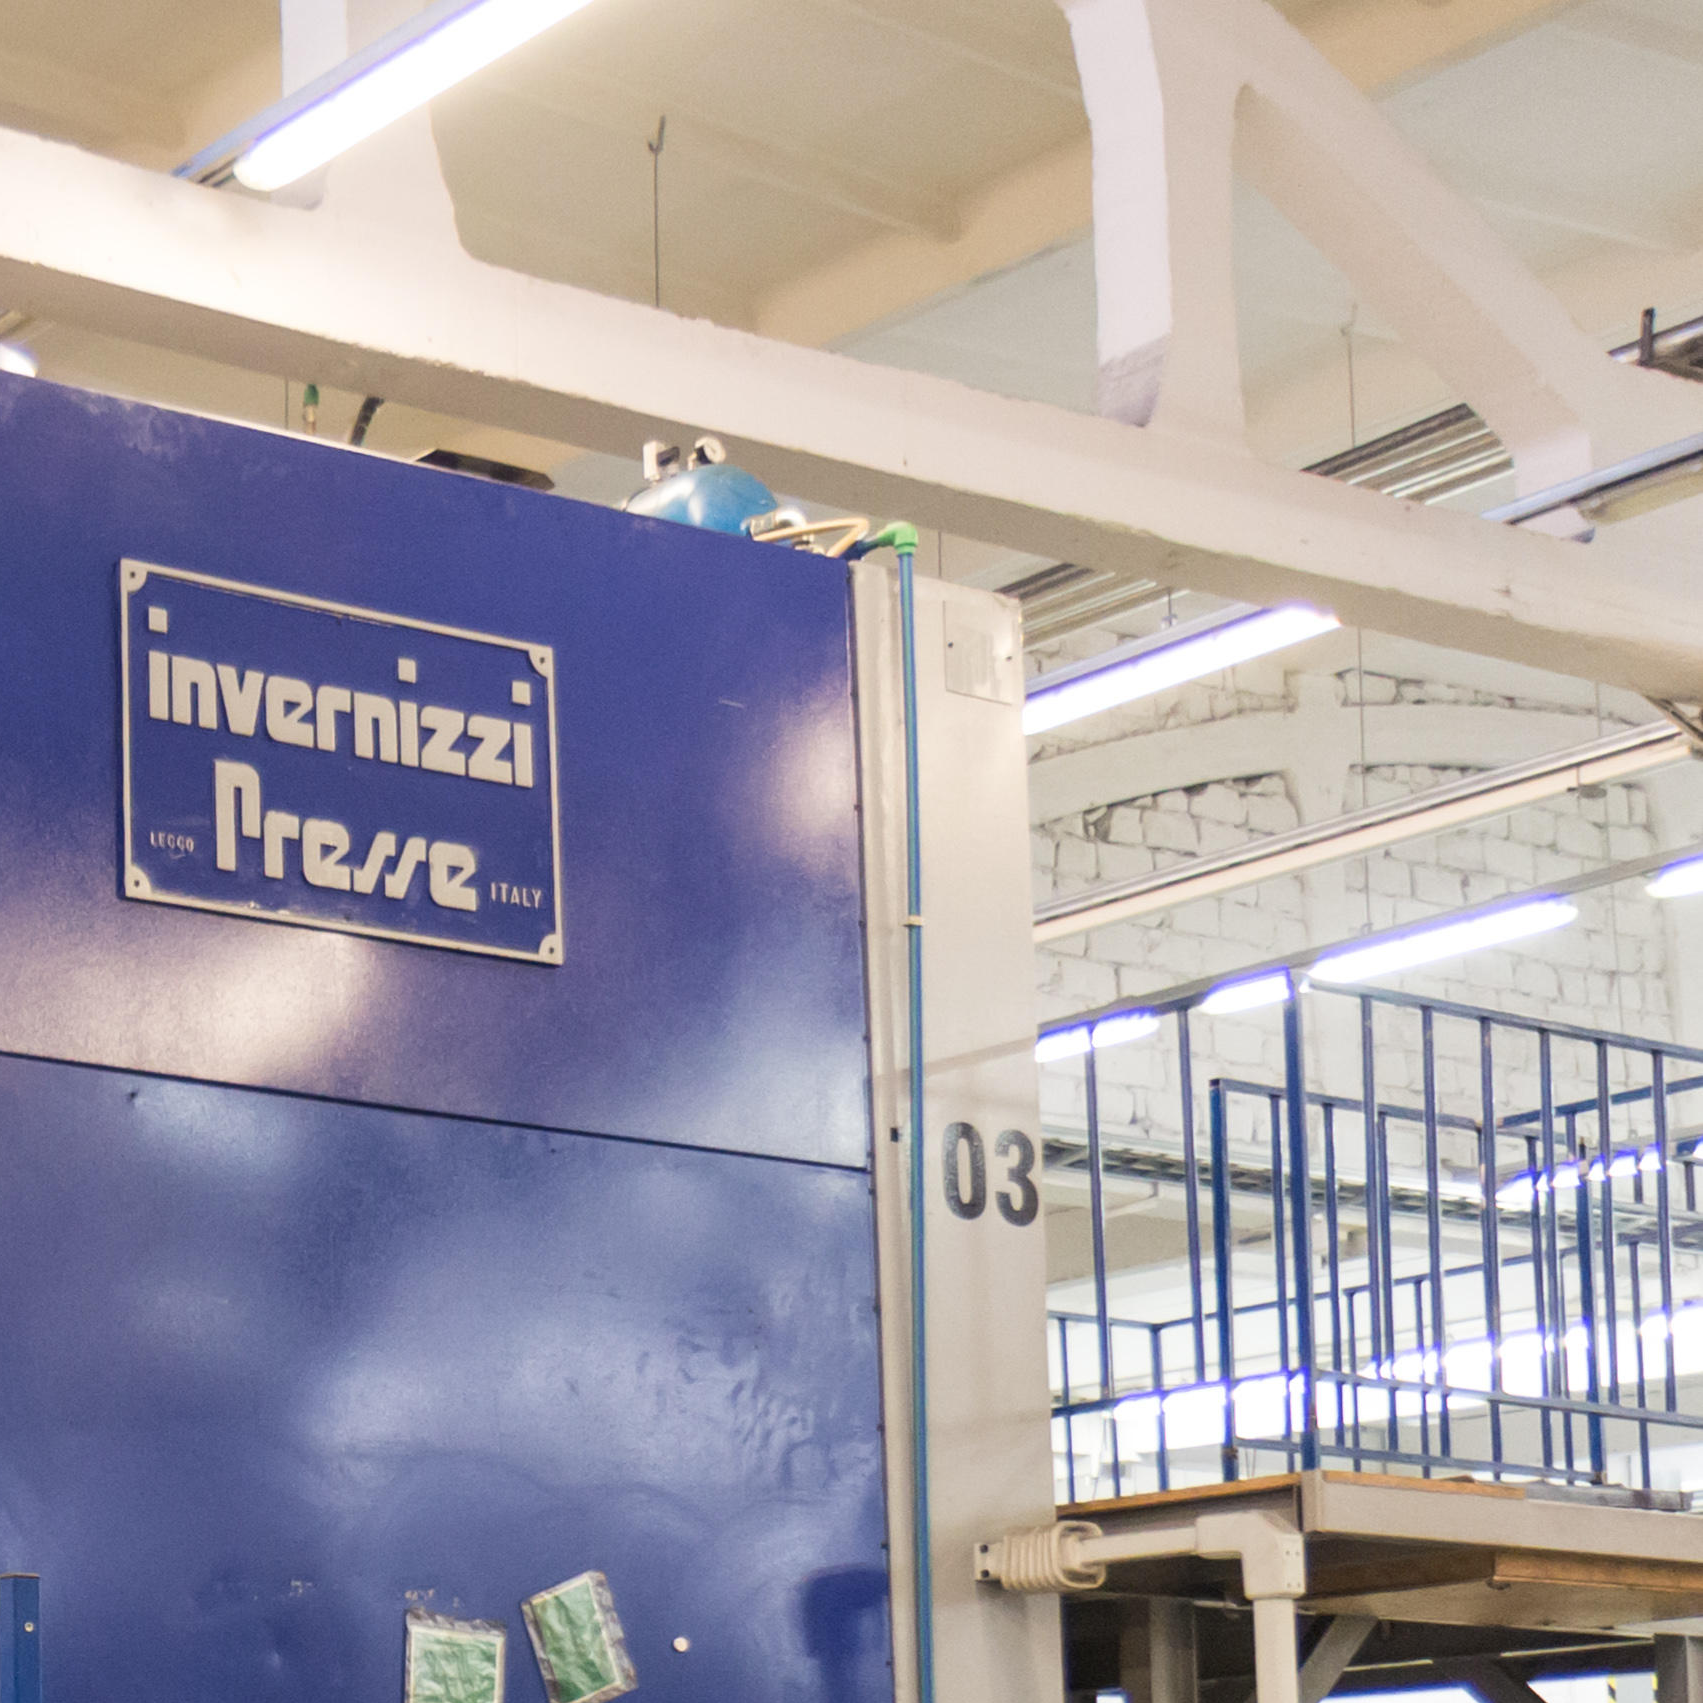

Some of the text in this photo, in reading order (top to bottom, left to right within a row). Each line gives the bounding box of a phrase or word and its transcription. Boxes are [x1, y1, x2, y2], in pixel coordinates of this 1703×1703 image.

[147, 605, 534, 789] invernizzi
[214, 758, 477, 912] Presse
[490, 882, 542, 909] ITALY
[941, 1121, 1040, 1227] 03
